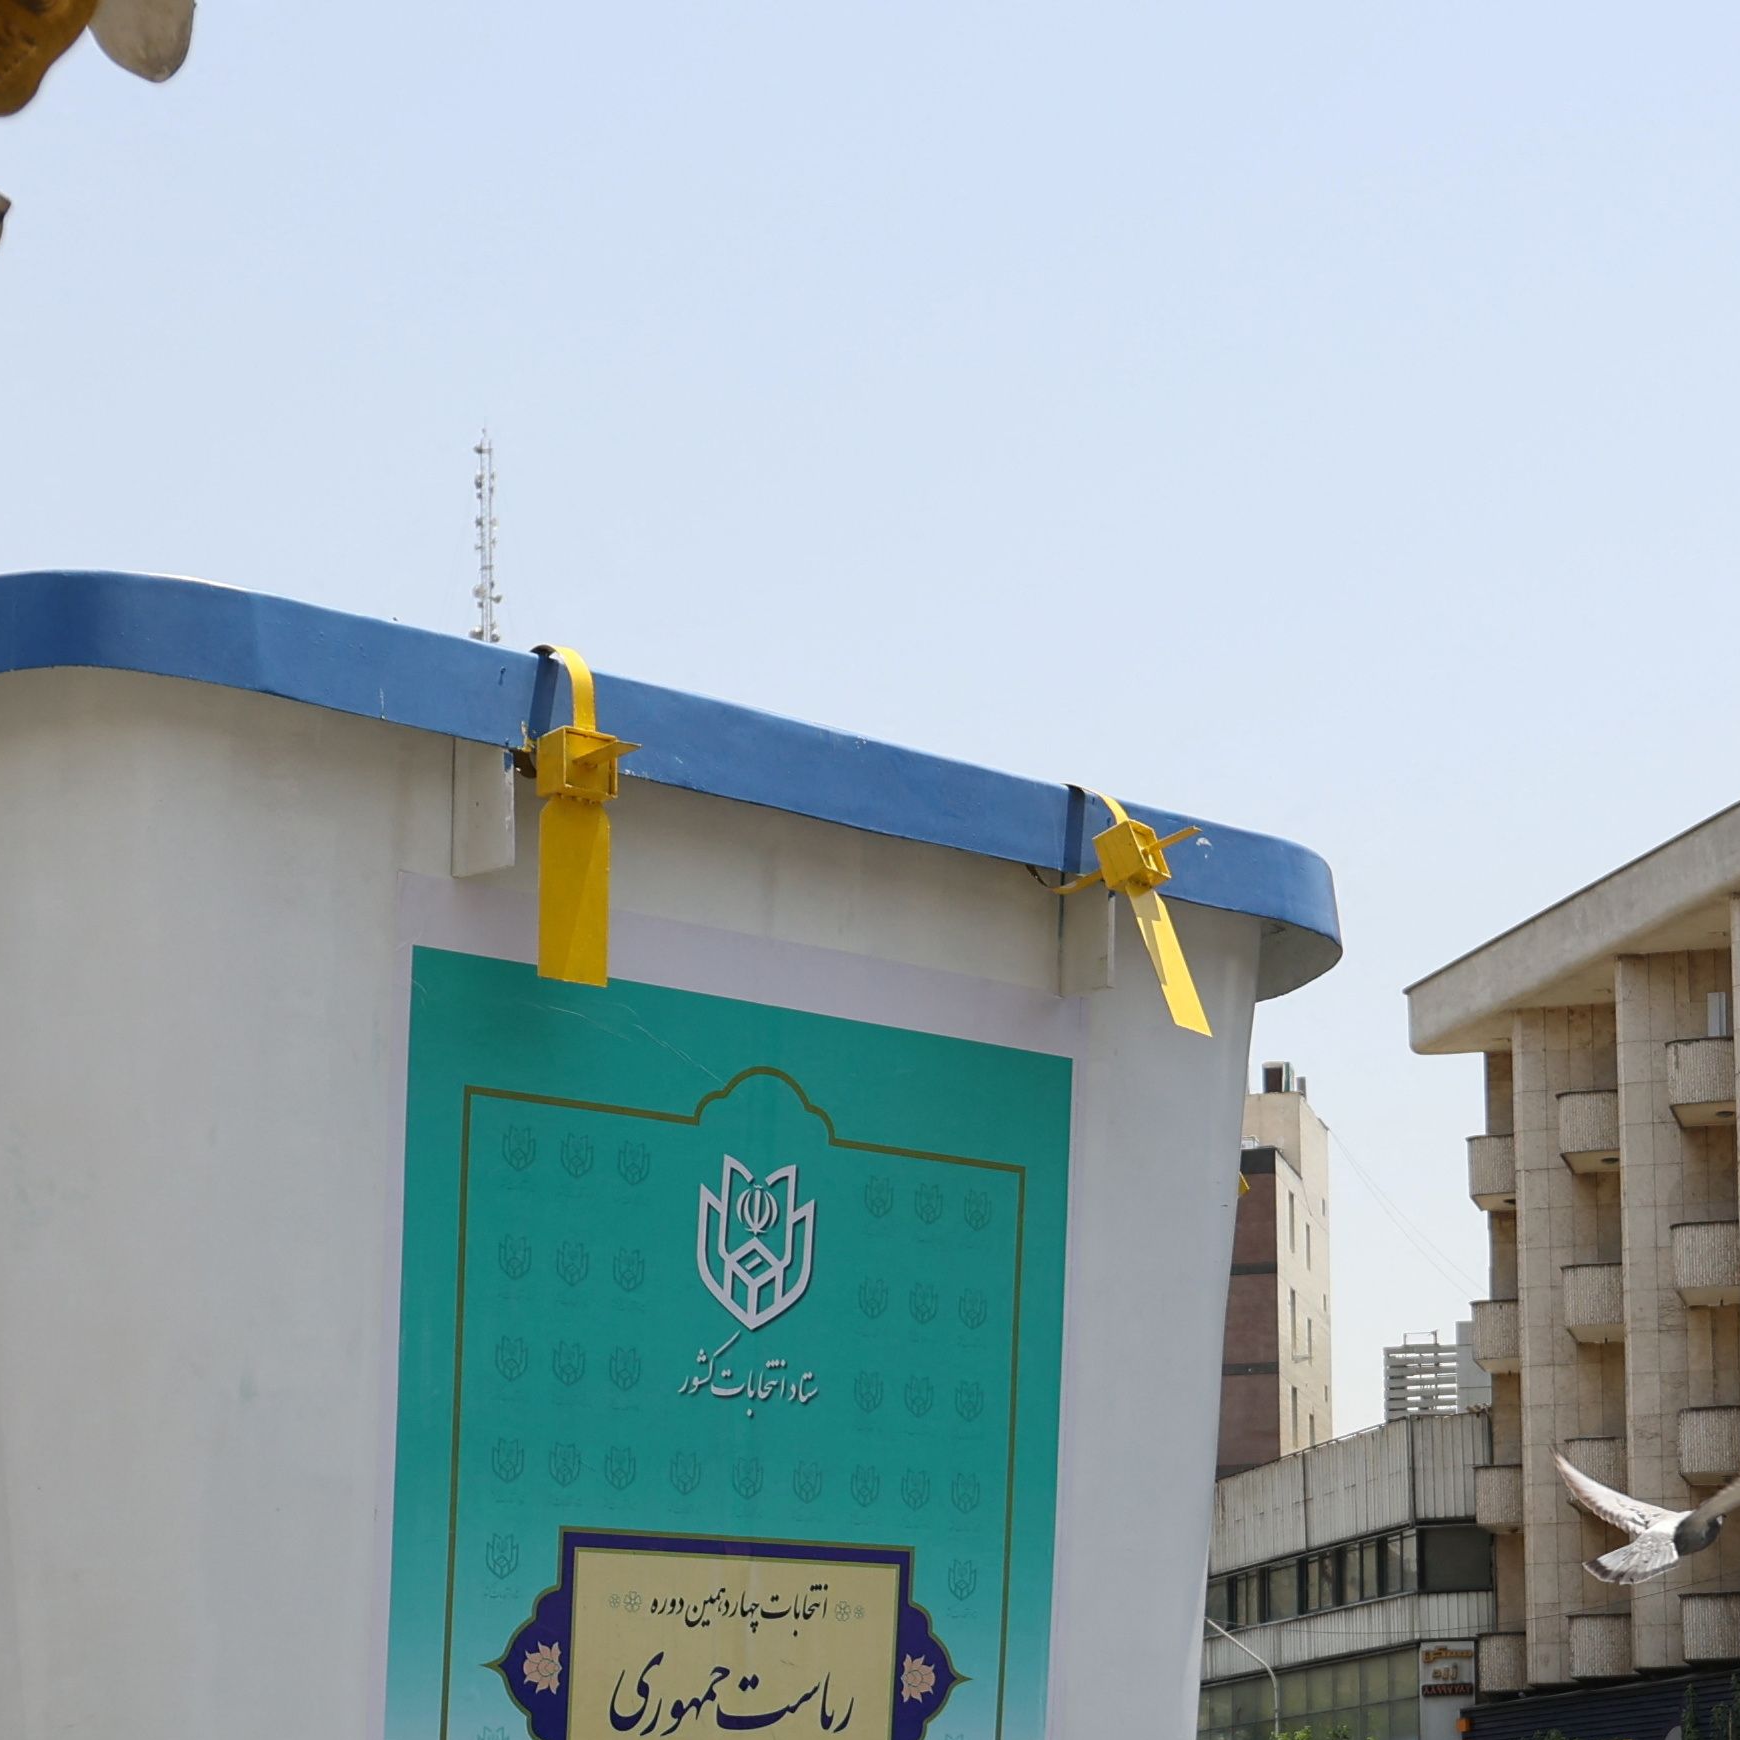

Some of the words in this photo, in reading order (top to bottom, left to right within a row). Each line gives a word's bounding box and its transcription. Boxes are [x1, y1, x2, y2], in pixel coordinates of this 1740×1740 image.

[678, 1329, 741, 1394] کشور
[710, 1358, 787, 1417] انتخابات
[787, 1371, 818, 1404] ستاد
[650, 1597, 685, 1616] دوره
[760, 1583, 829, 1637] انتخابات
